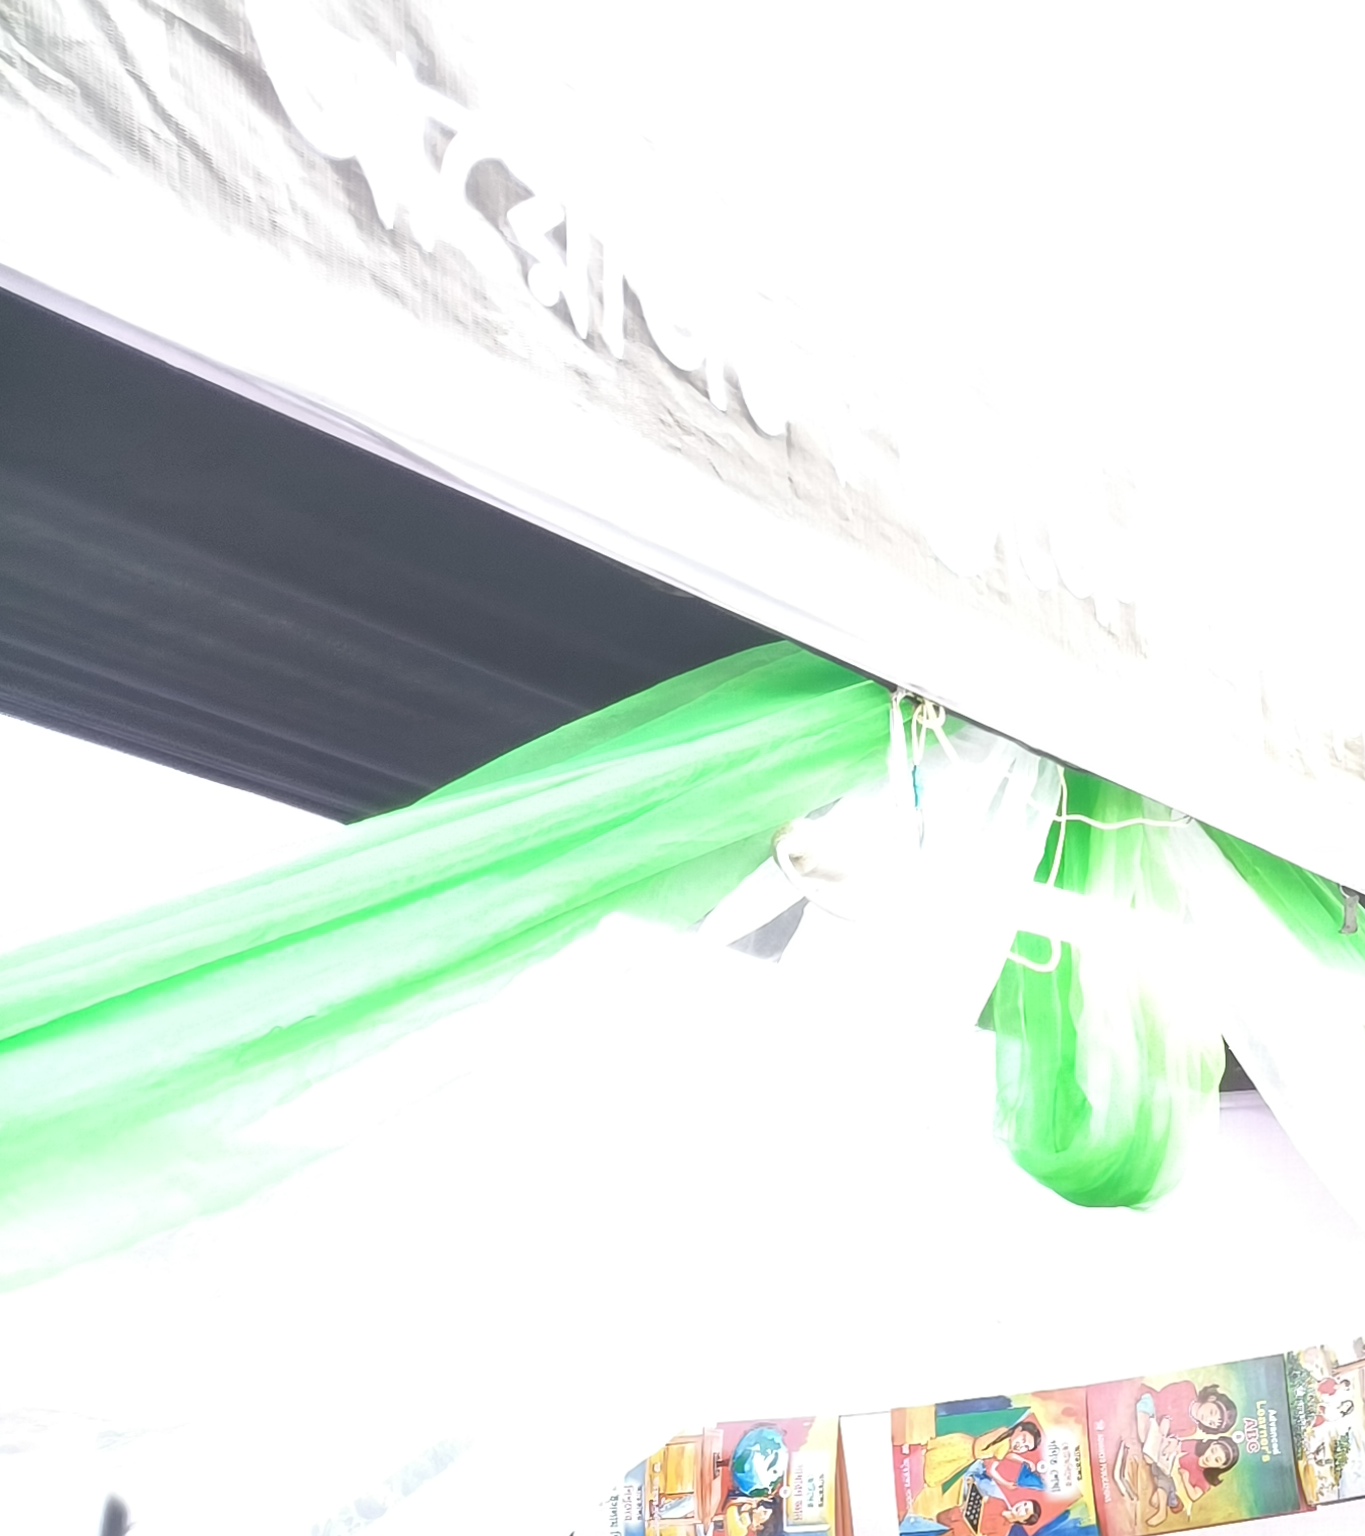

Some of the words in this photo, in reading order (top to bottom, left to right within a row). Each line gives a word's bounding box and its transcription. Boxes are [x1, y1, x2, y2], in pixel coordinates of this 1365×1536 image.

[1243, 1418, 1259, 1453] ABC
[1255, 1400, 1269, 1462] Learner's
[1268, 1409, 1281, 1454] Advanced
